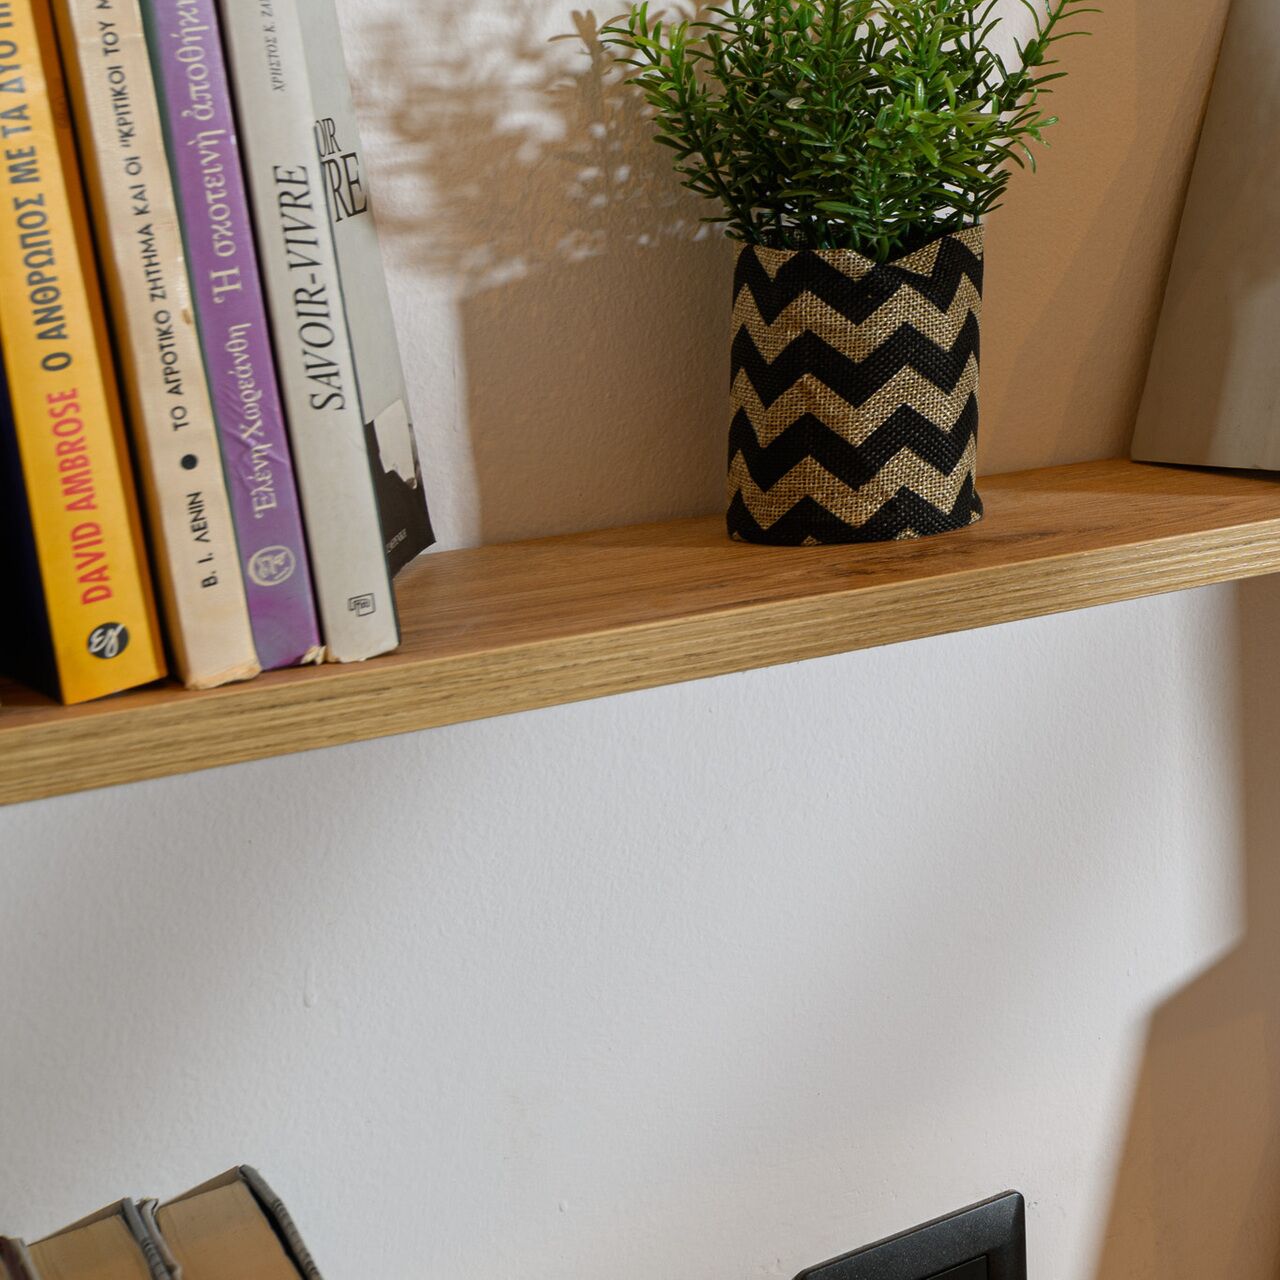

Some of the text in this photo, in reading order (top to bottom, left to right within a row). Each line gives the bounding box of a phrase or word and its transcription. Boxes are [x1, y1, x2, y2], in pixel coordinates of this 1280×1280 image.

[99, 21, 120, 57] ΤΟΥ
[0, 103, 32, 139] ΤΑ
[5, 145, 41, 185] ΜΕ
[124, 155, 143, 176] ΟΙ
[129, 183, 152, 216] ΚΑΙ
[13, 193, 69, 340] ΑΝΘΡΩΠΟΣ
[137, 224, 167, 302] ΖΗΤΗΜΑ
[273, 165, 347, 411] SAVOIR-VIVRE
[40, 351, 73, 372] Ο
[153, 310, 184, 396] ΑΓΡΟΤΙΚΟ
[171, 405, 189, 432] ΤΟ
[46, 387, 116, 606] DAVID AMBROSE
[186, 491, 211, 543] ΛΕΝΙΝ
